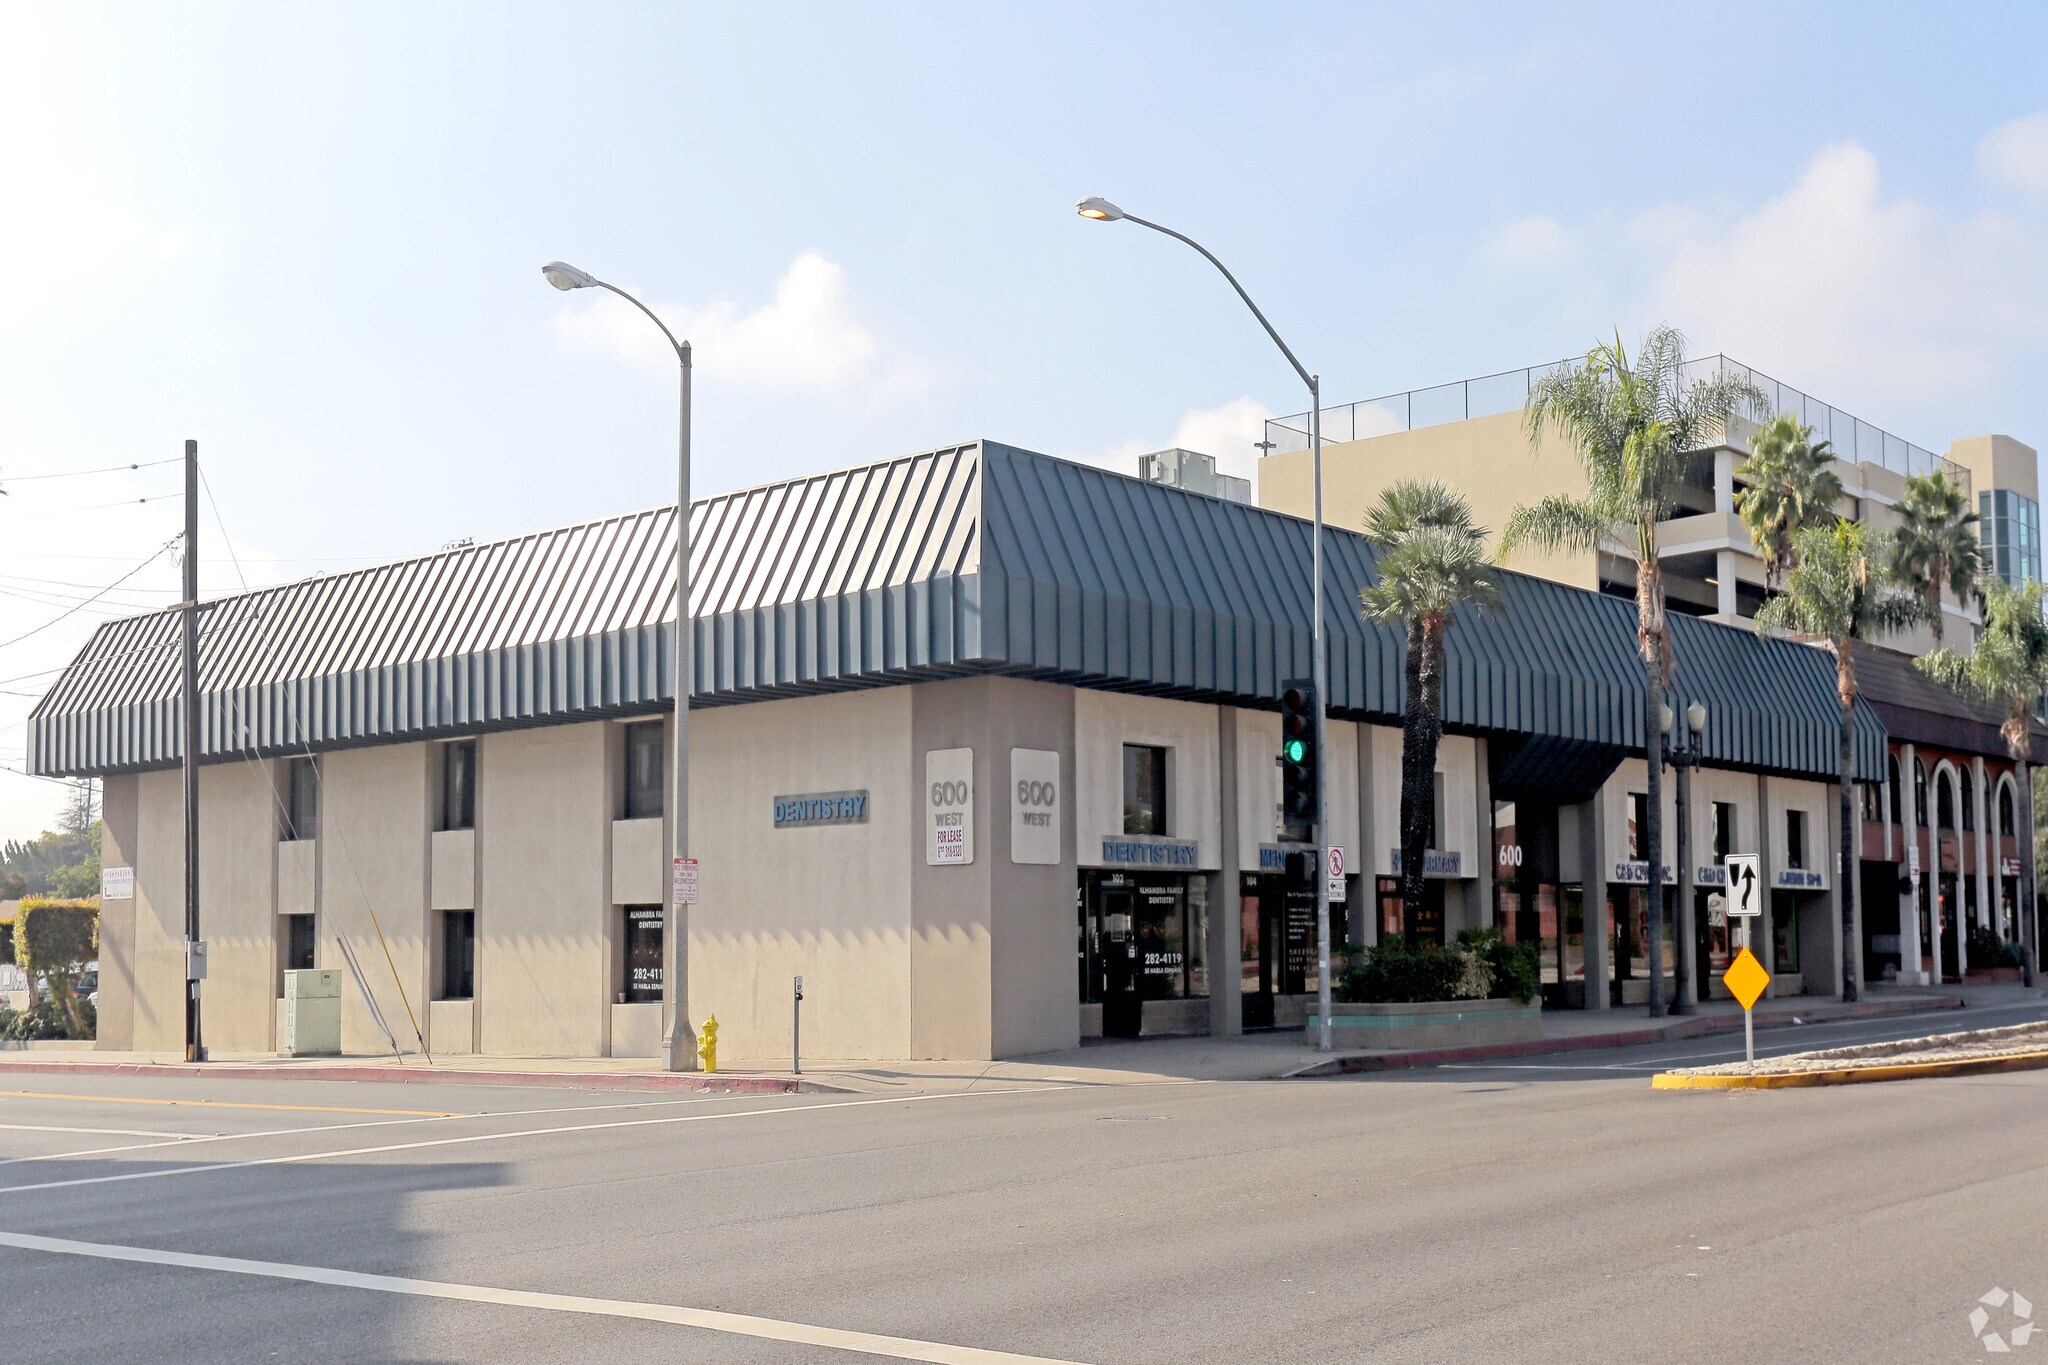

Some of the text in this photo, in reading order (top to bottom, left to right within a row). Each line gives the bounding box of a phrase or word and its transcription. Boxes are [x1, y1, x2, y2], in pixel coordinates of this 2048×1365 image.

[931, 780, 967, 807] 600
[1017, 780, 1055, 807] 600
[774, 796, 866, 822] DENTISTRY
[935, 812, 964, 826] WEST
[1022, 811, 1051, 827] WEST
[937, 829, 962, 843] FOR LEASE
[1103, 841, 1196, 865] DENTISTRY
[1500, 845, 1522, 866] 600
[681, 864, 698, 872] PARKING
[1422, 855, 1459, 873] ARMACY
[1112, 873, 1124, 884] 102
[1139, 886, 1166, 895] ALHAMBRA
[630, 910, 655, 919] ALHAMBRA
[638, 921, 664, 929] DENTISTRY
[1144, 952, 1182, 965] 282-4119
[633, 968, 663, 980] 282-411
